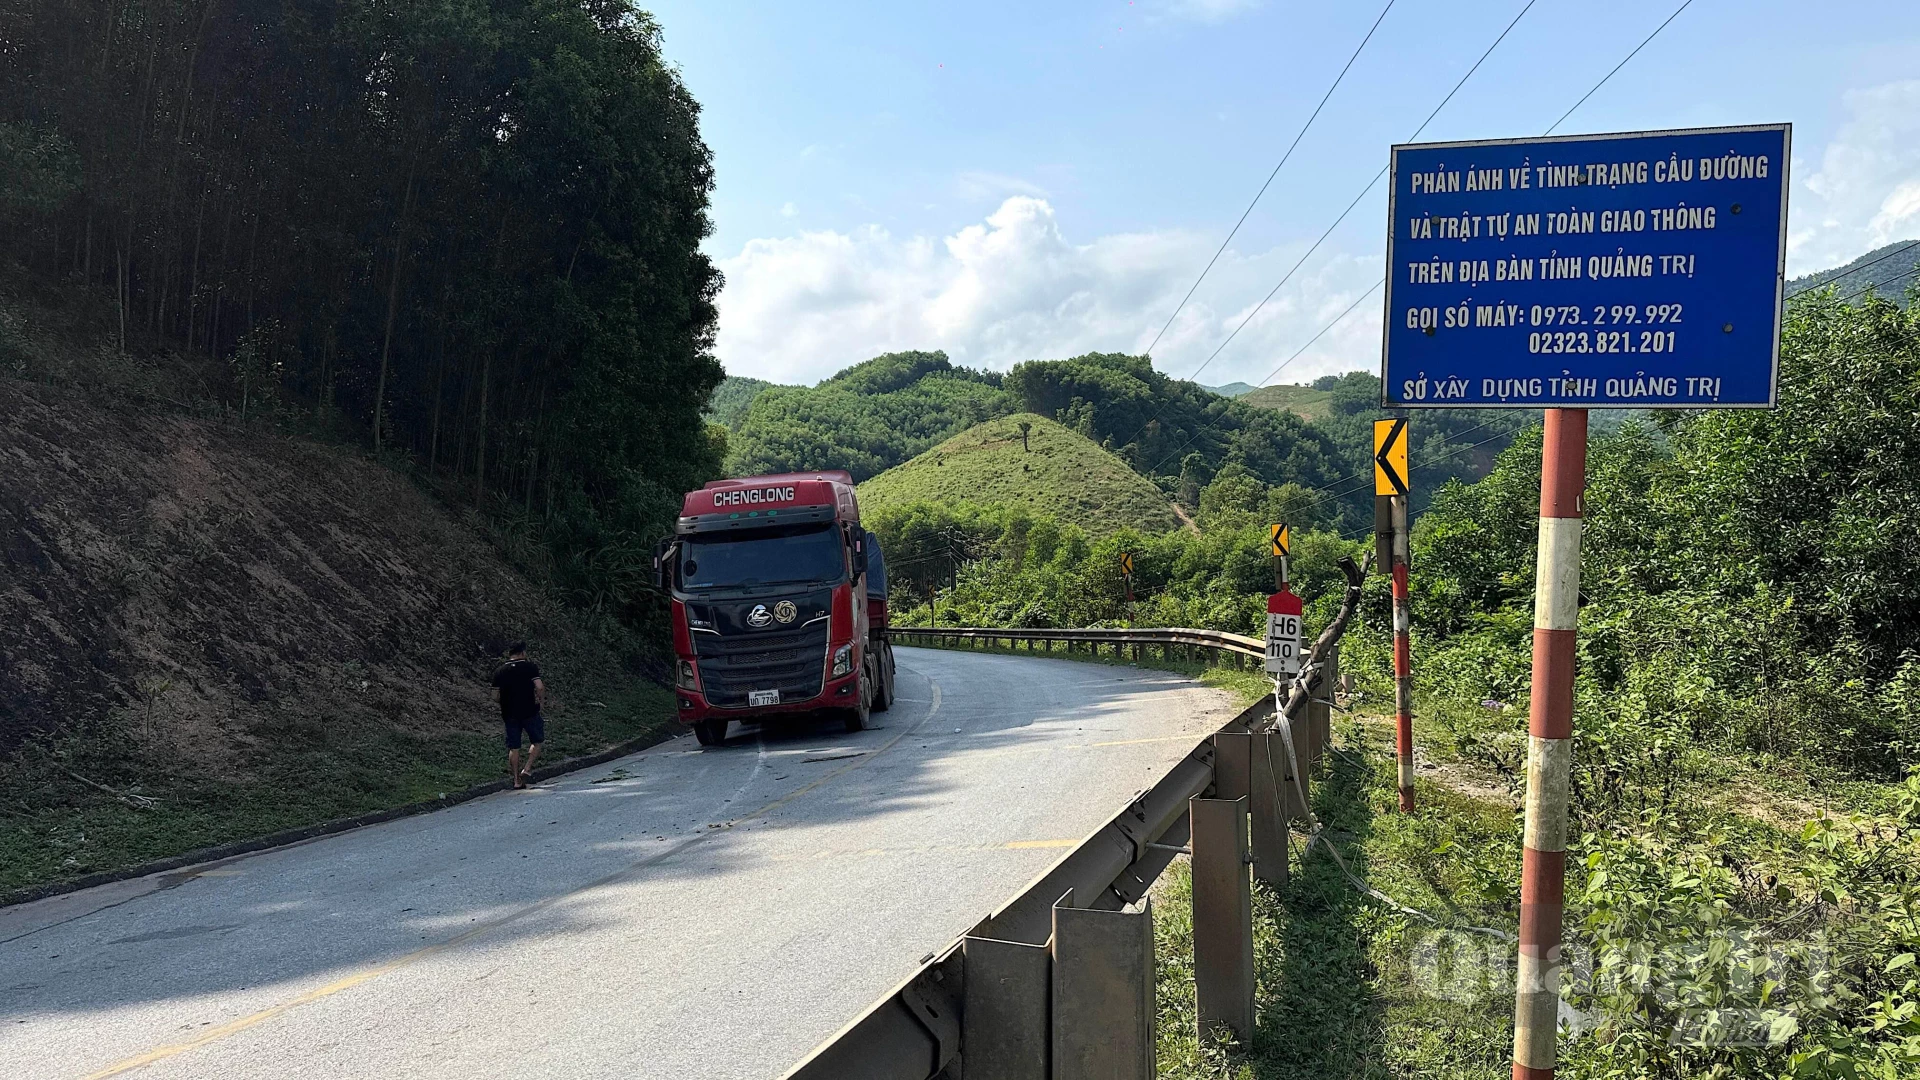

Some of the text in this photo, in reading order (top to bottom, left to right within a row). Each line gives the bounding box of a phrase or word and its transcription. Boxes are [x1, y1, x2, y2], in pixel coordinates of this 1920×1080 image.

[1411, 149, 1768, 193] PHẢN ÁNH VỀ TÌNH TRẠNG CẦU ĐƯỜNG
[1411, 202, 1716, 242] VÀ TRẬT TỰ AN TOÀN GIAO THÔNG
[1408, 247, 1695, 287] TRÊN ĐỊA BÀN TỈNH QUẢNG TRỊ
[1406, 307, 1438, 333] GỌI
[1445, 298, 1471, 328] SỐ
[1475, 300, 1524, 327] MÁY:
[1403, 370, 1722, 402] SỞ XÂY DỰNG TỈNH QUẢNG TRỊ
[714, 487, 794, 506] CHENGLONG
[1272, 617, 1296, 635] H6
[1271, 643, 1291, 658] 110
[762, 696, 778, 705] 7798
